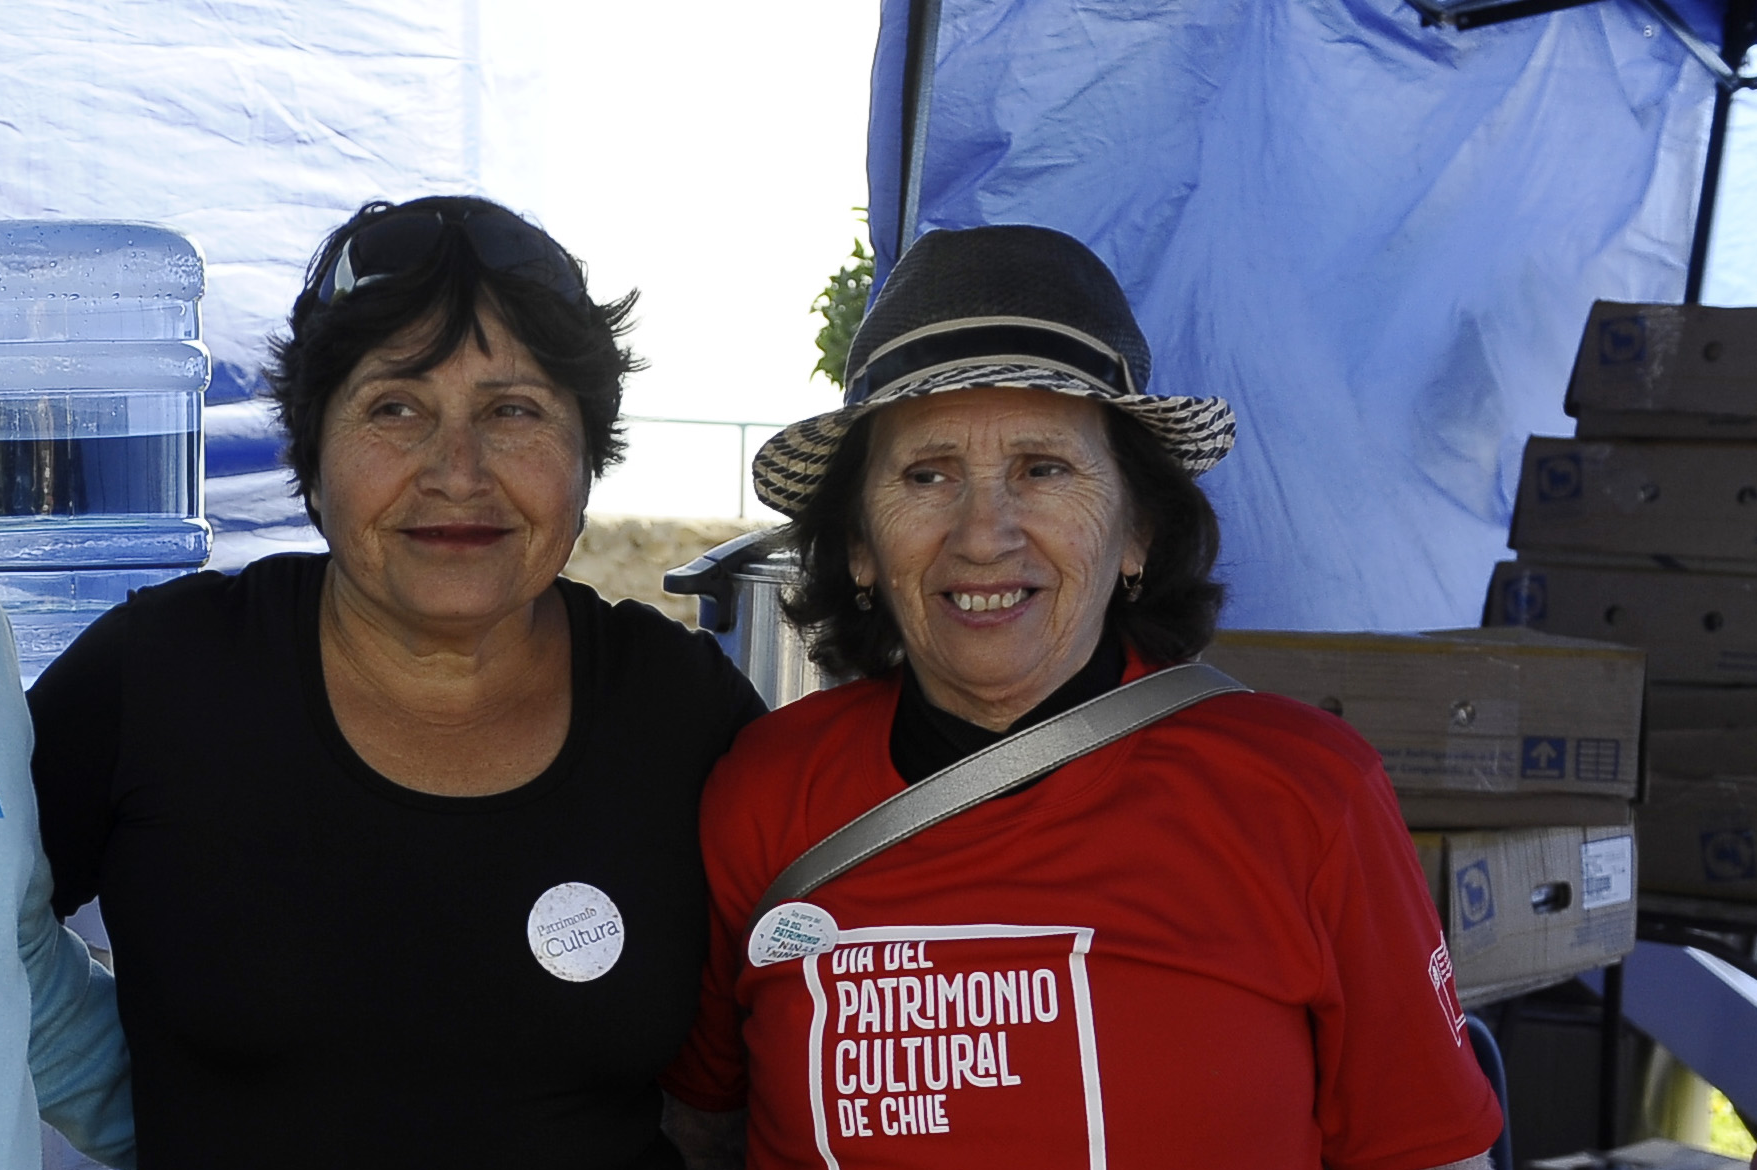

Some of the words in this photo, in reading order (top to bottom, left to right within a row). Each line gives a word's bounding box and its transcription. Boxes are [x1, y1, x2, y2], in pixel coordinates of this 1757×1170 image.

[546, 920, 620, 957] Cultura
[884, 940, 934, 971] DEL
[836, 968, 1059, 1033] PATRIMONIO
[835, 1031, 1021, 1094] CULTURAL
[838, 1098, 873, 1137] DE
[880, 1094, 950, 1136] CHILE
